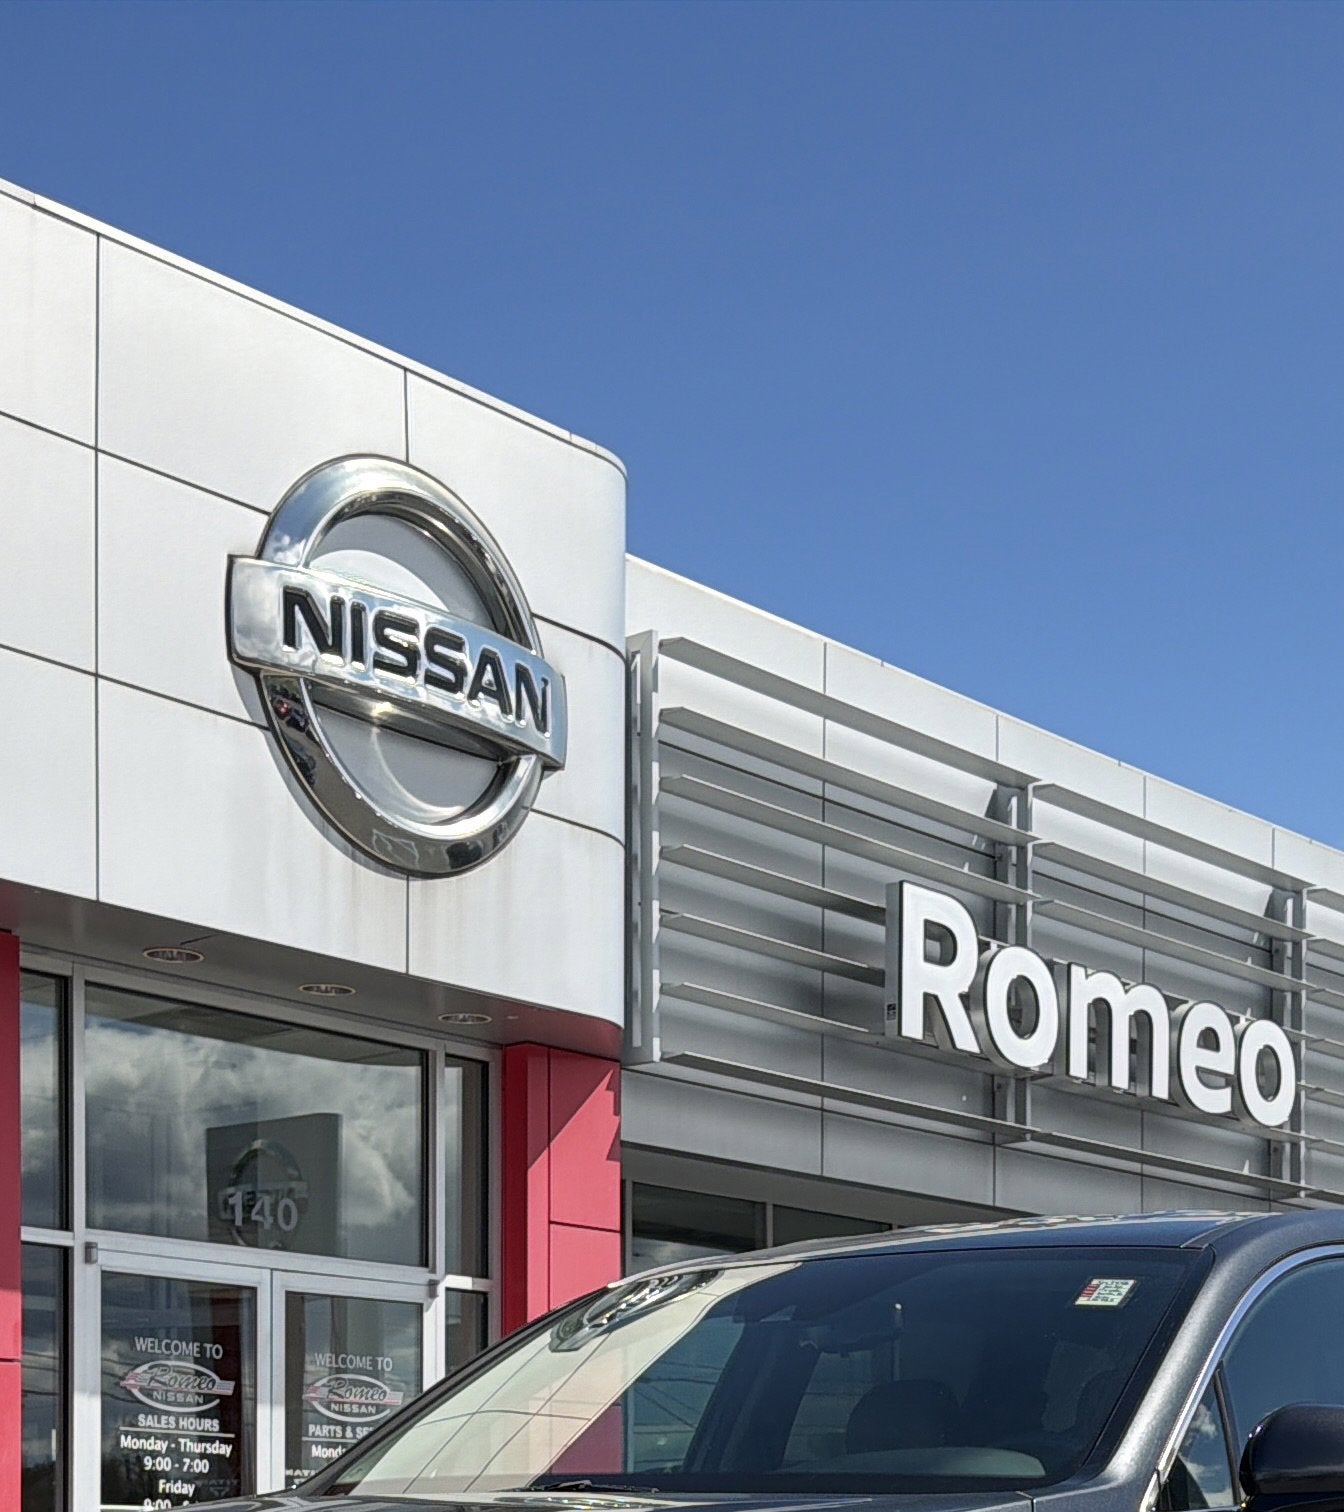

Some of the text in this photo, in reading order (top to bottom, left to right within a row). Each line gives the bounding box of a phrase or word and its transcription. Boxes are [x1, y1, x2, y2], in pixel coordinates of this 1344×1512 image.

[282, 585, 551, 738] NISSAN
[898, 880, 1296, 1127] Romeo
[228, 1192, 298, 1231] 140
[135, 1336, 223, 1359] WELCOME TO
[315, 1353, 393, 1371] WELCOME TO
[145, 1363, 216, 1391] Romeo
[152, 1391, 204, 1403] NISSAN
[321, 1377, 387, 1401] Romeo
[330, 1402, 376, 1414] NISSAN
[137, 1413, 220, 1432] SALES HOURS
[308, 1424, 343, 1437] PARTS
[345, 1426, 354, 1438] &
[120, 1434, 168, 1454] Monday
[178, 1438, 233, 1458] Thursday
[144, 1455, 172, 1471] 9:00
[182, 1458, 210, 1473] 7:00
[158, 1479, 196, 1497] Friday
